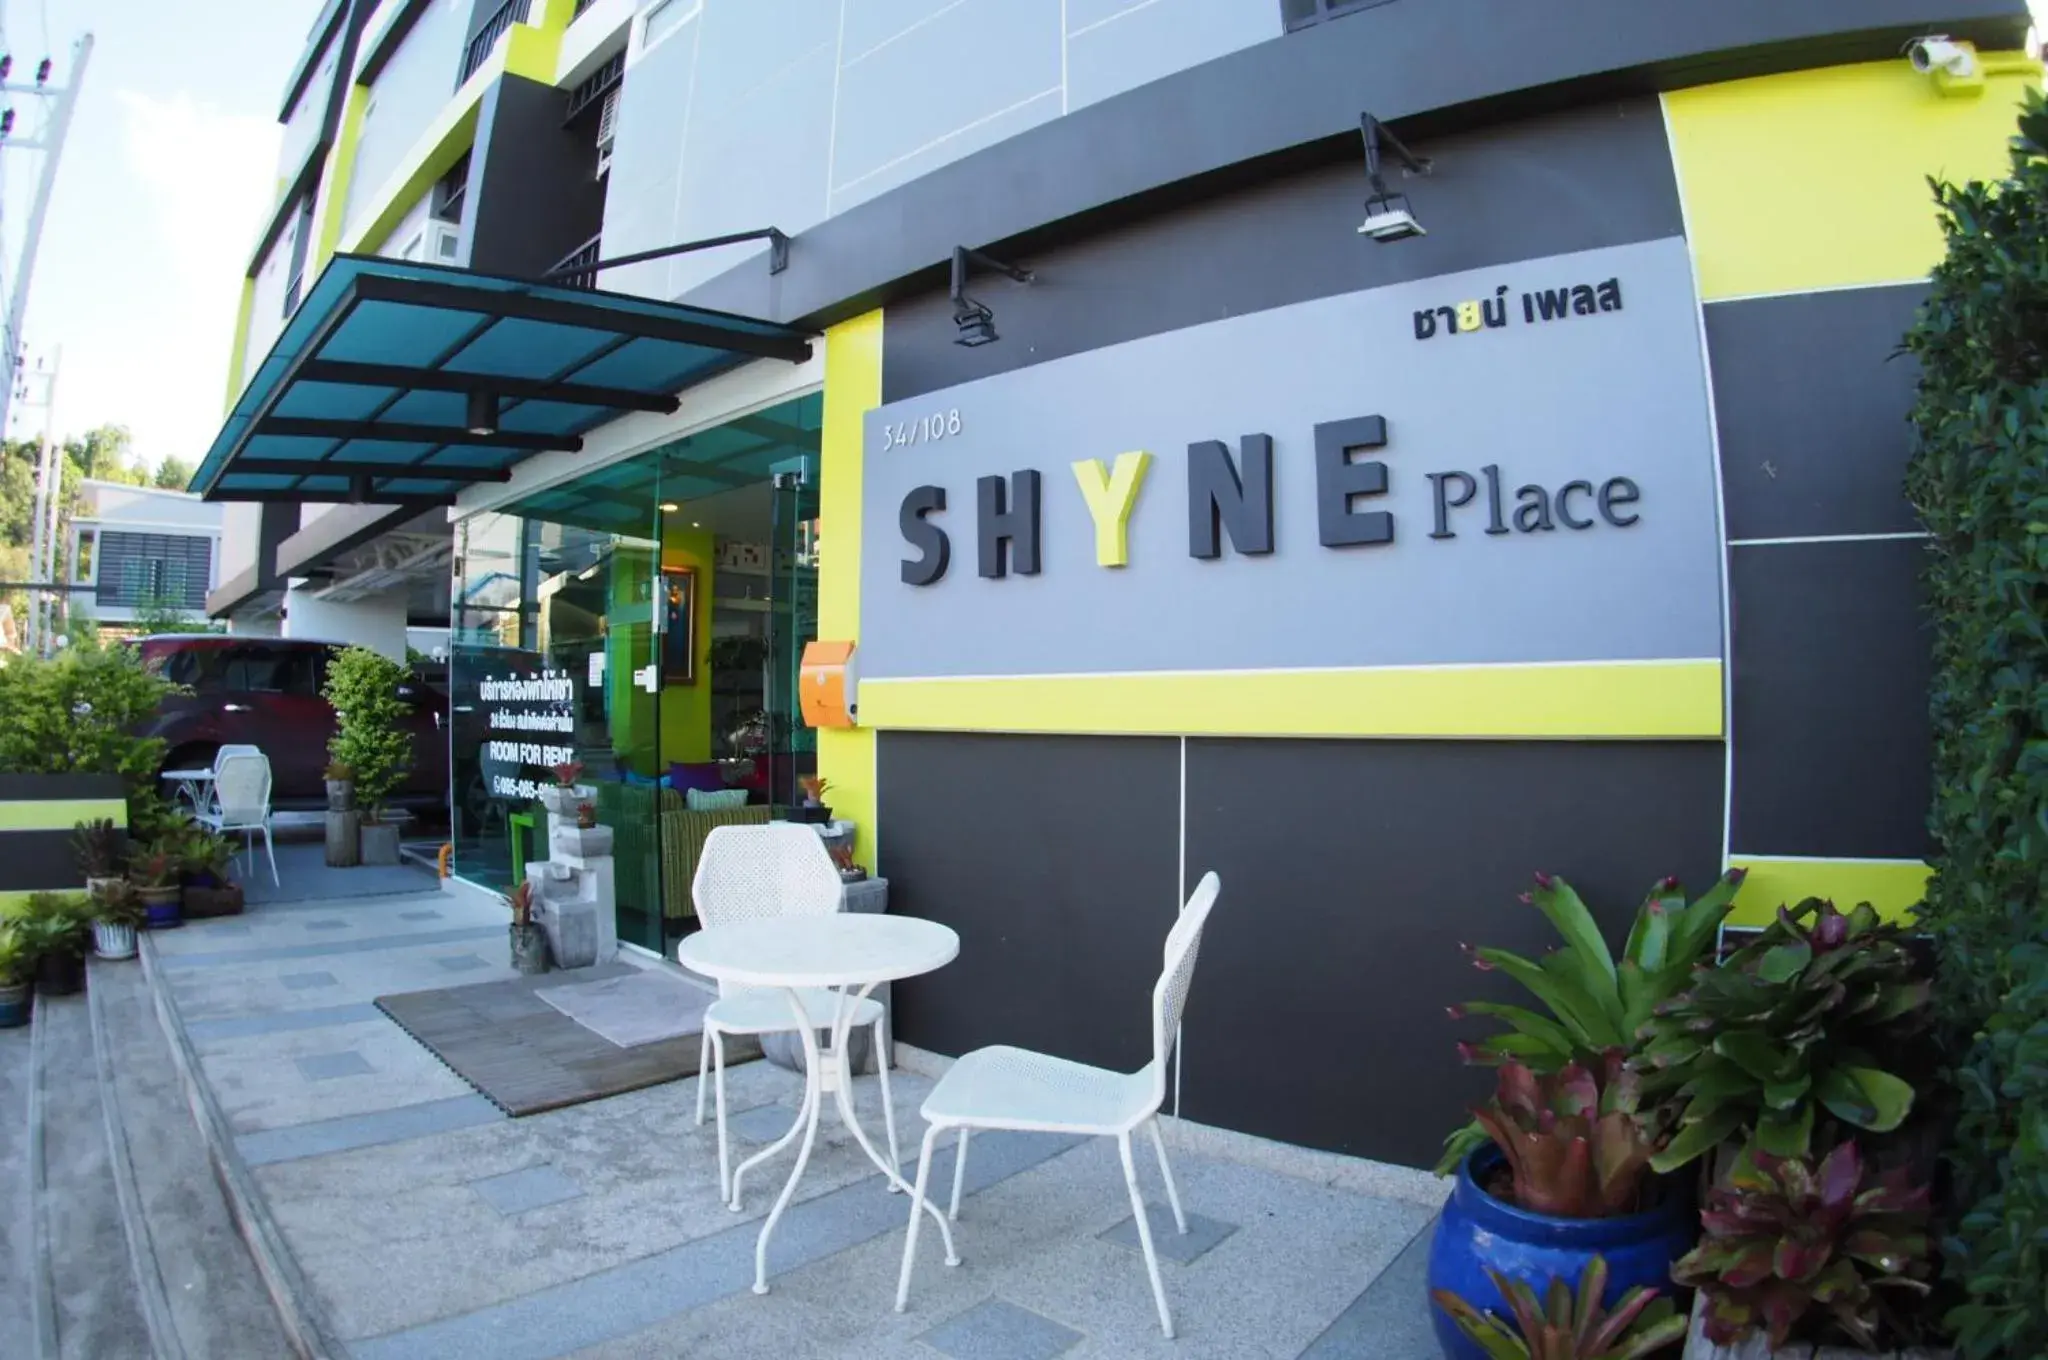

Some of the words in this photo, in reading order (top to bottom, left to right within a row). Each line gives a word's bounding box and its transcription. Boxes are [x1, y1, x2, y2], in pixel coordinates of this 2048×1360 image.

[1522, 277, 1624, 324] เพลส
[899, 413, 1395, 587] SHYNE
[1424, 464, 1640, 540] Place
[489, 740, 519, 763] ROOM
[519, 743, 542, 766] FOR
[542, 745, 574, 768] RENT
